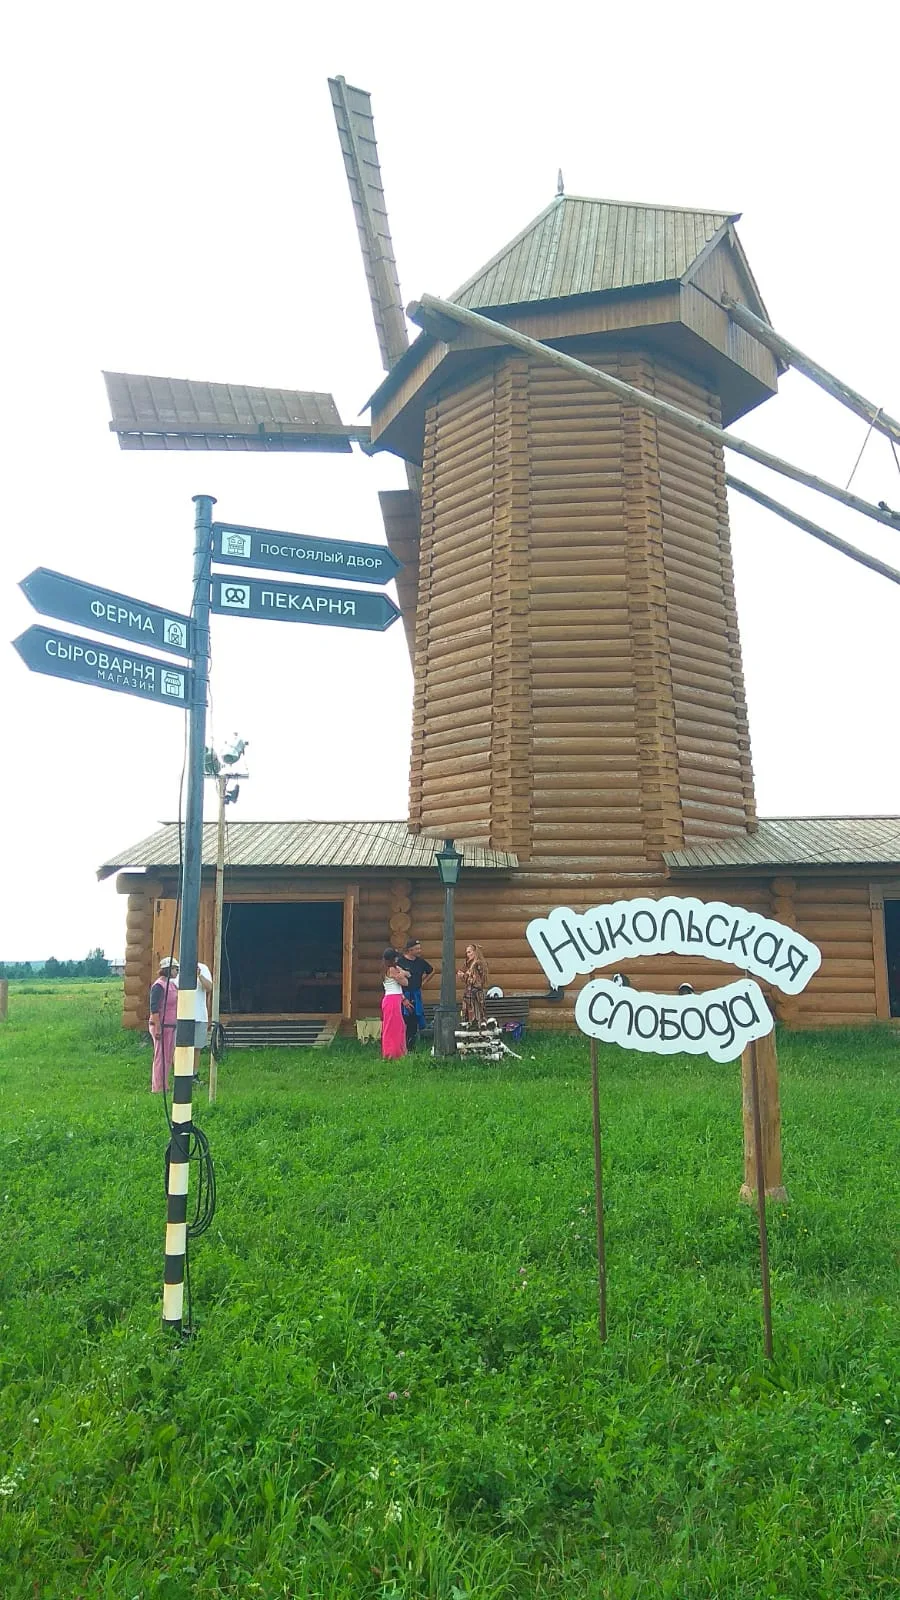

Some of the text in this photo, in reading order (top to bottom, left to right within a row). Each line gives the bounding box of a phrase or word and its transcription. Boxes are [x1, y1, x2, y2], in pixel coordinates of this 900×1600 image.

[260, 543, 382, 569] ПОСТОЯЛЫЙ ДВОР
[90, 600, 154, 633] ФЕРМА
[261, 591, 355, 616] ПЕКАРНЯ
[45, 639, 154, 681] СЫРОВАРНЯ
[97, 670, 154, 691] МАГАЗИН
